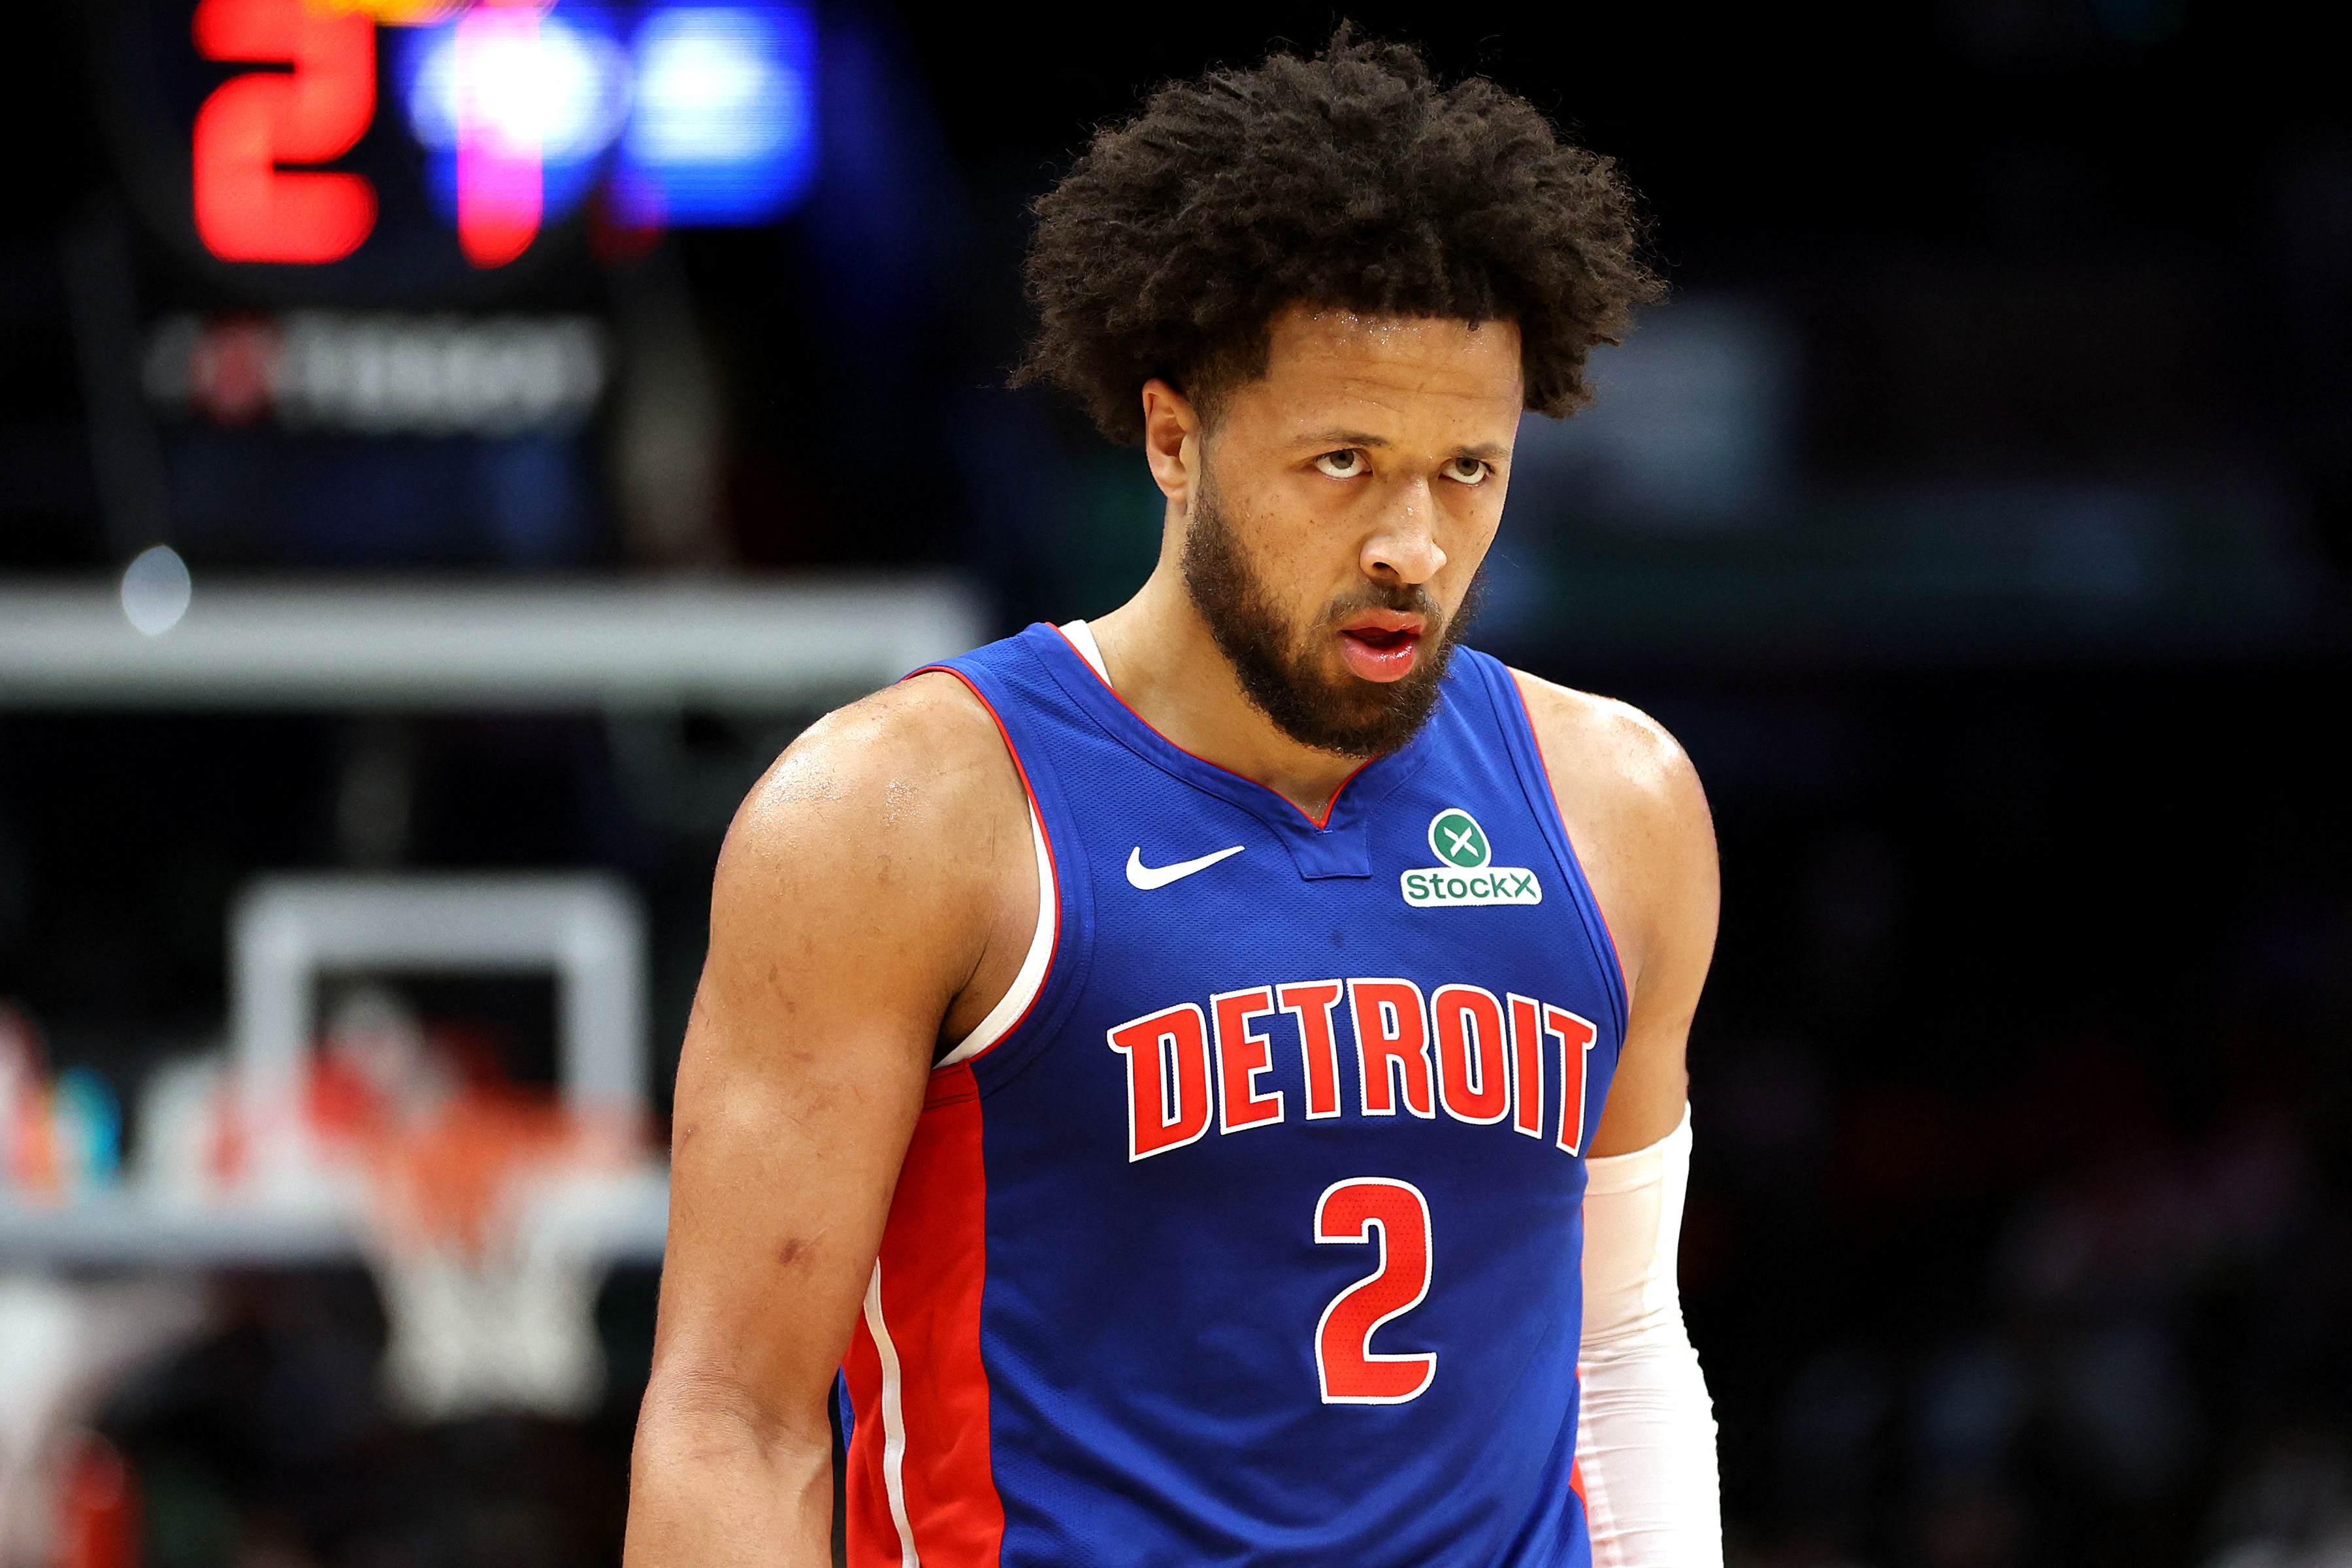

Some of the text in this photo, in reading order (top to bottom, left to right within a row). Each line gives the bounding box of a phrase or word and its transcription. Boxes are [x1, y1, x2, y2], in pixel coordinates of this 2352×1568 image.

[1406, 872, 1537, 900] StockX
[1107, 977, 1597, 1163] DETROIT
[1314, 1177, 1437, 1405] 2
